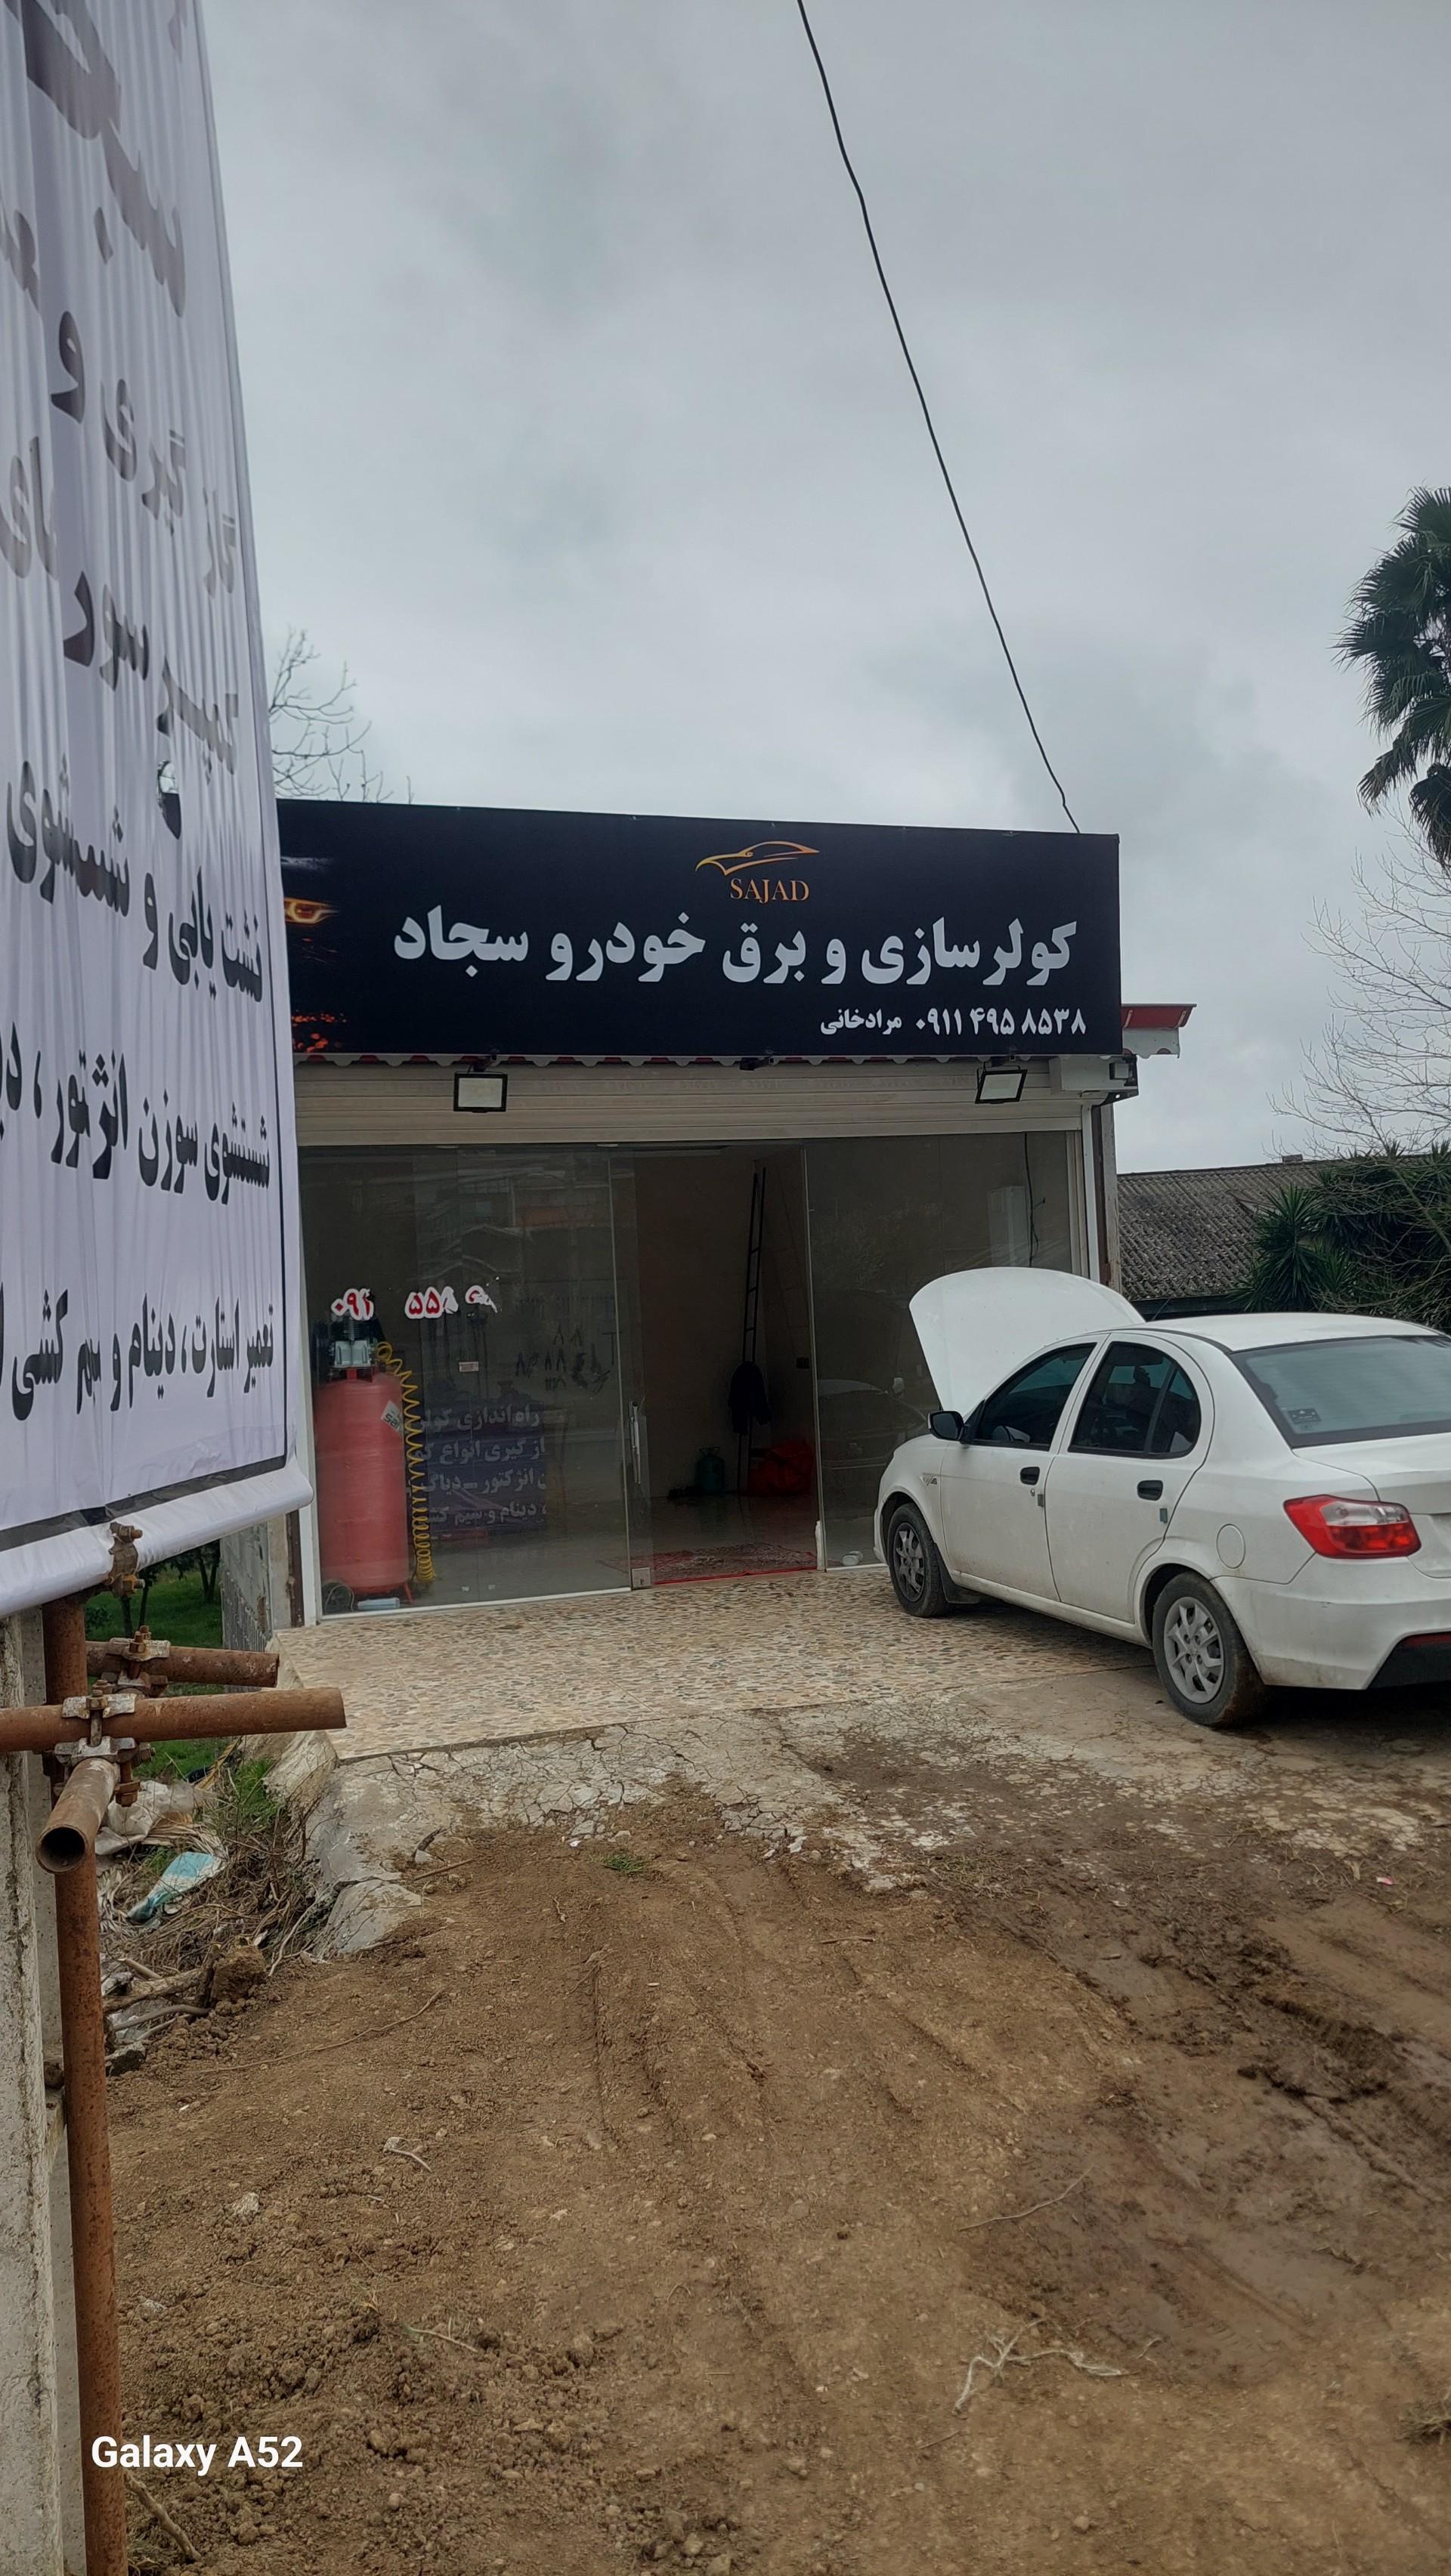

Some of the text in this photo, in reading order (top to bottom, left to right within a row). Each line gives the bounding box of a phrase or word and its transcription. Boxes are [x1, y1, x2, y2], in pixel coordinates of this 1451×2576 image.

[7, 753, 130, 917] شسشوی
[143, 872, 159, 971] و
[730, 878, 809, 903] SAJAD
[394, 905, 529, 978] سجاد
[546, 912, 706, 982] خودرو
[722, 922, 806, 984] برق
[821, 939, 846, 985] و
[138, 1088, 198, 1195] سوزن
[11, 1288, 69, 1421] کشی
[110, 1332, 122, 1412] و
[129, 1291, 176, 1409] دینام
[243, 1303, 274, 1394] تعمیر
